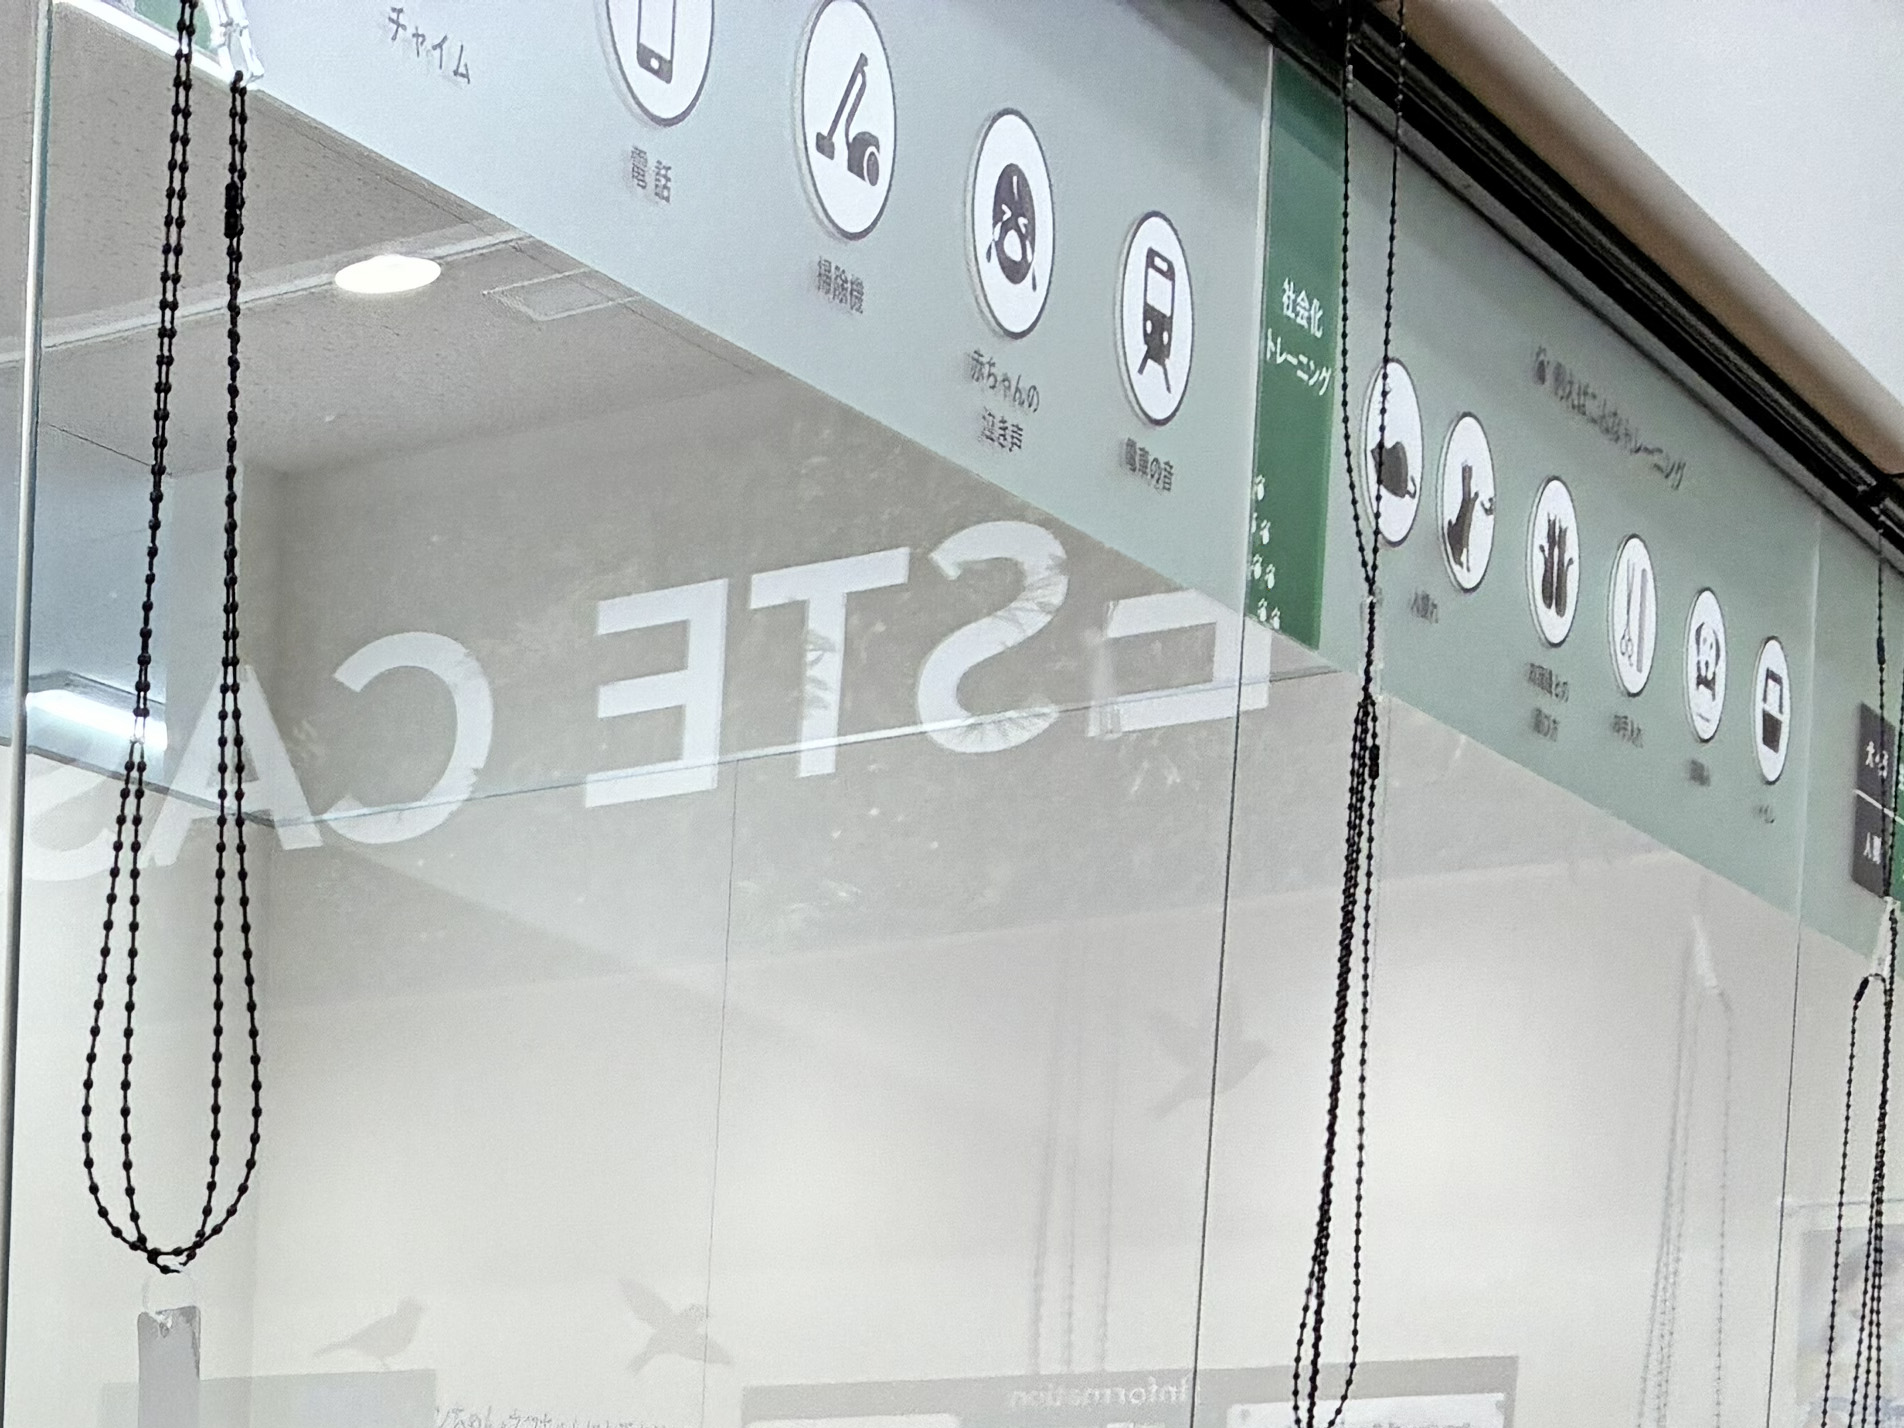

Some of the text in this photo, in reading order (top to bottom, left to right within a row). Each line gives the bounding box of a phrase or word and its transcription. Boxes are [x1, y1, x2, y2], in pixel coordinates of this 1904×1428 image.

[388, 6, 472, 84] チャイム
[1281, 276, 1325, 340] 社会化
[970, 349, 1040, 413] 赤ちゃんの
[1264, 327, 1332, 396] トレーニング
